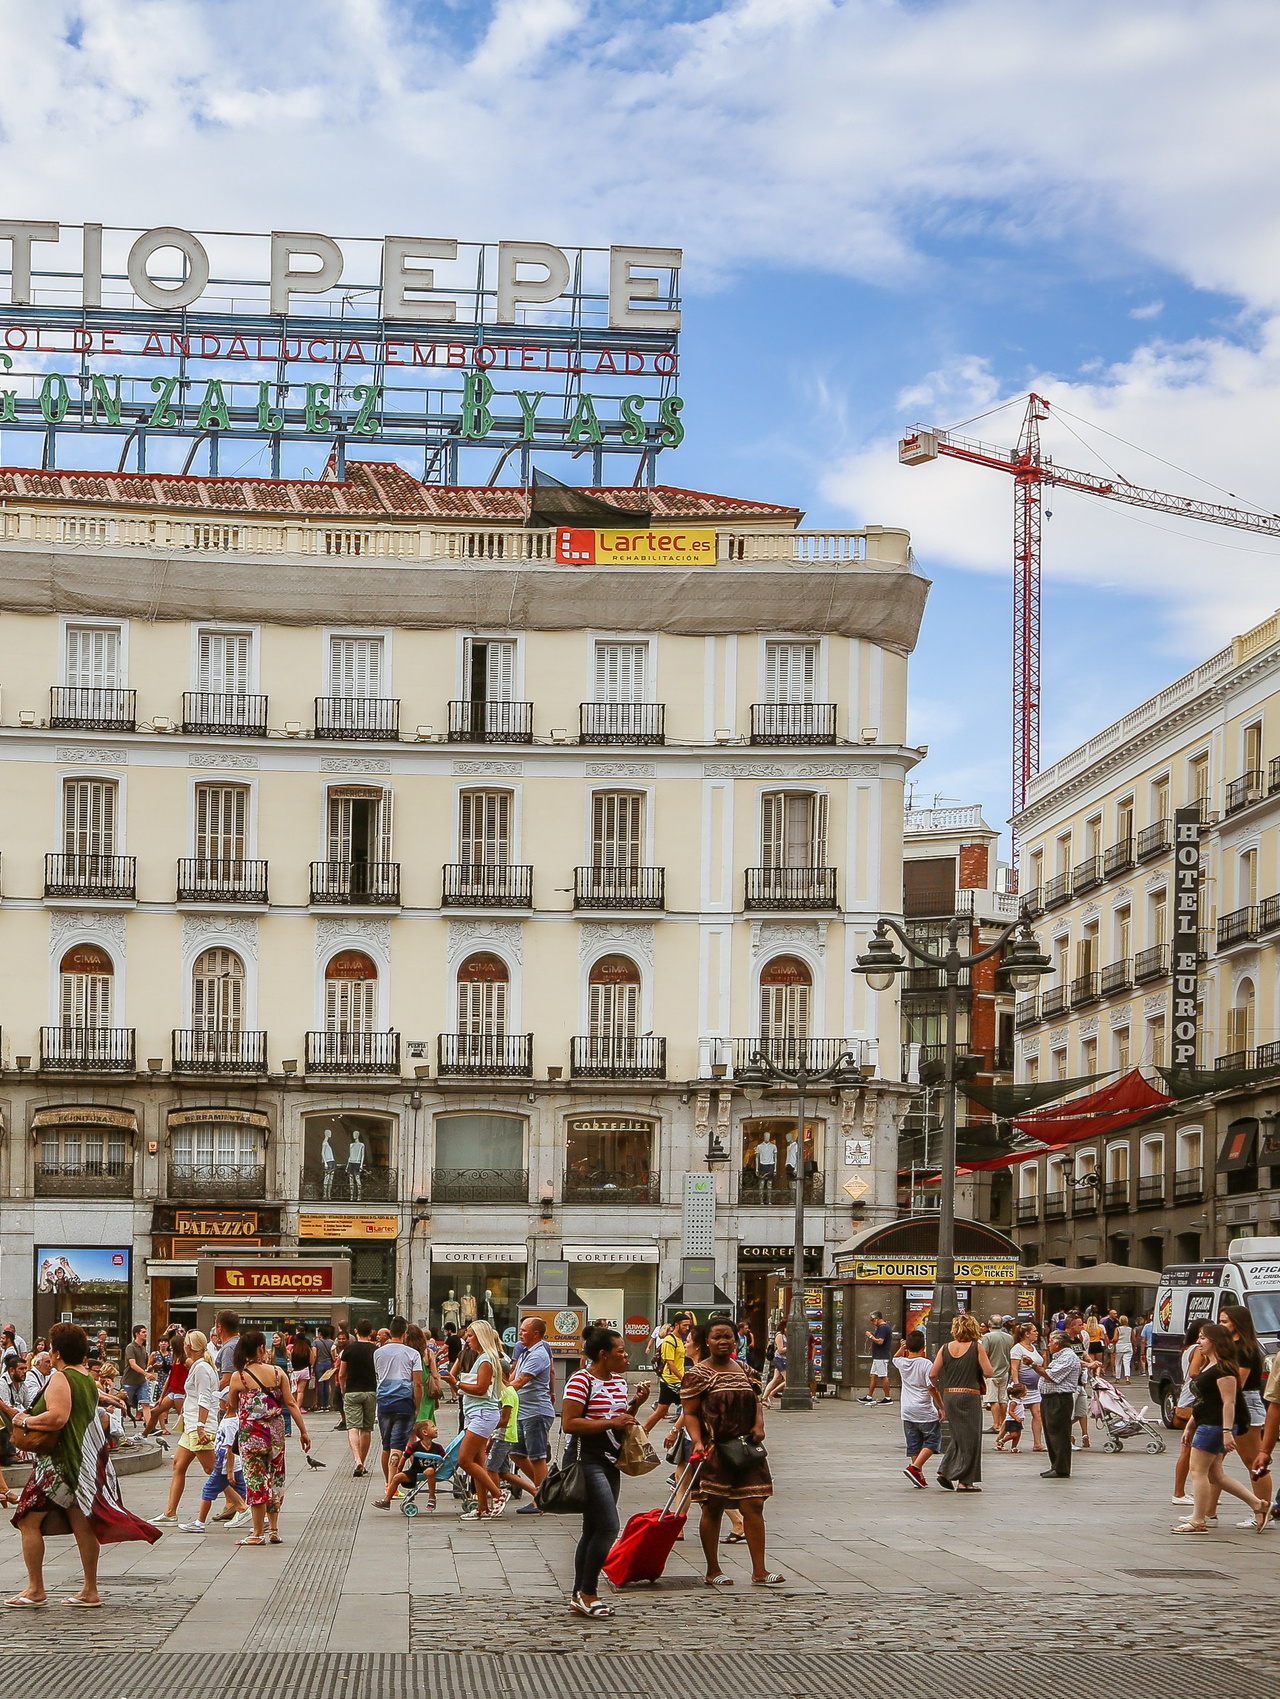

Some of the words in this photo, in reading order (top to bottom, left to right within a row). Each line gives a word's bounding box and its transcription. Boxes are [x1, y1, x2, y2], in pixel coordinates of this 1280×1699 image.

[271, 230, 683, 331] PEPE
[74, 328, 122, 354] DE
[142, 331, 366, 364] ANDALUCIA
[385, 340, 677, 376] EMBOTELLADO
[600, 532, 711, 552] Lartec.es
[1177, 823, 1200, 934] HOTEL
[1175, 952, 1197, 1066] EUROP
[573, 1122, 650, 1131] CORTEFIEL
[179, 1220, 255, 1236] PALAZZO
[445, 1253, 514, 1261] CORTEFIEL
[577, 1253, 646, 1261] CORTEFIEL
[743, 1248, 818, 1256] CORTEFEL
[877, 1264, 937, 1276] TOURIST
[954, 1264, 970, 1276] US
[983, 1270, 1014, 1278] TICKETS
[251, 1274, 323, 1286] TABACOS
[624, 1322, 650, 1331] ÚLTIMOS
